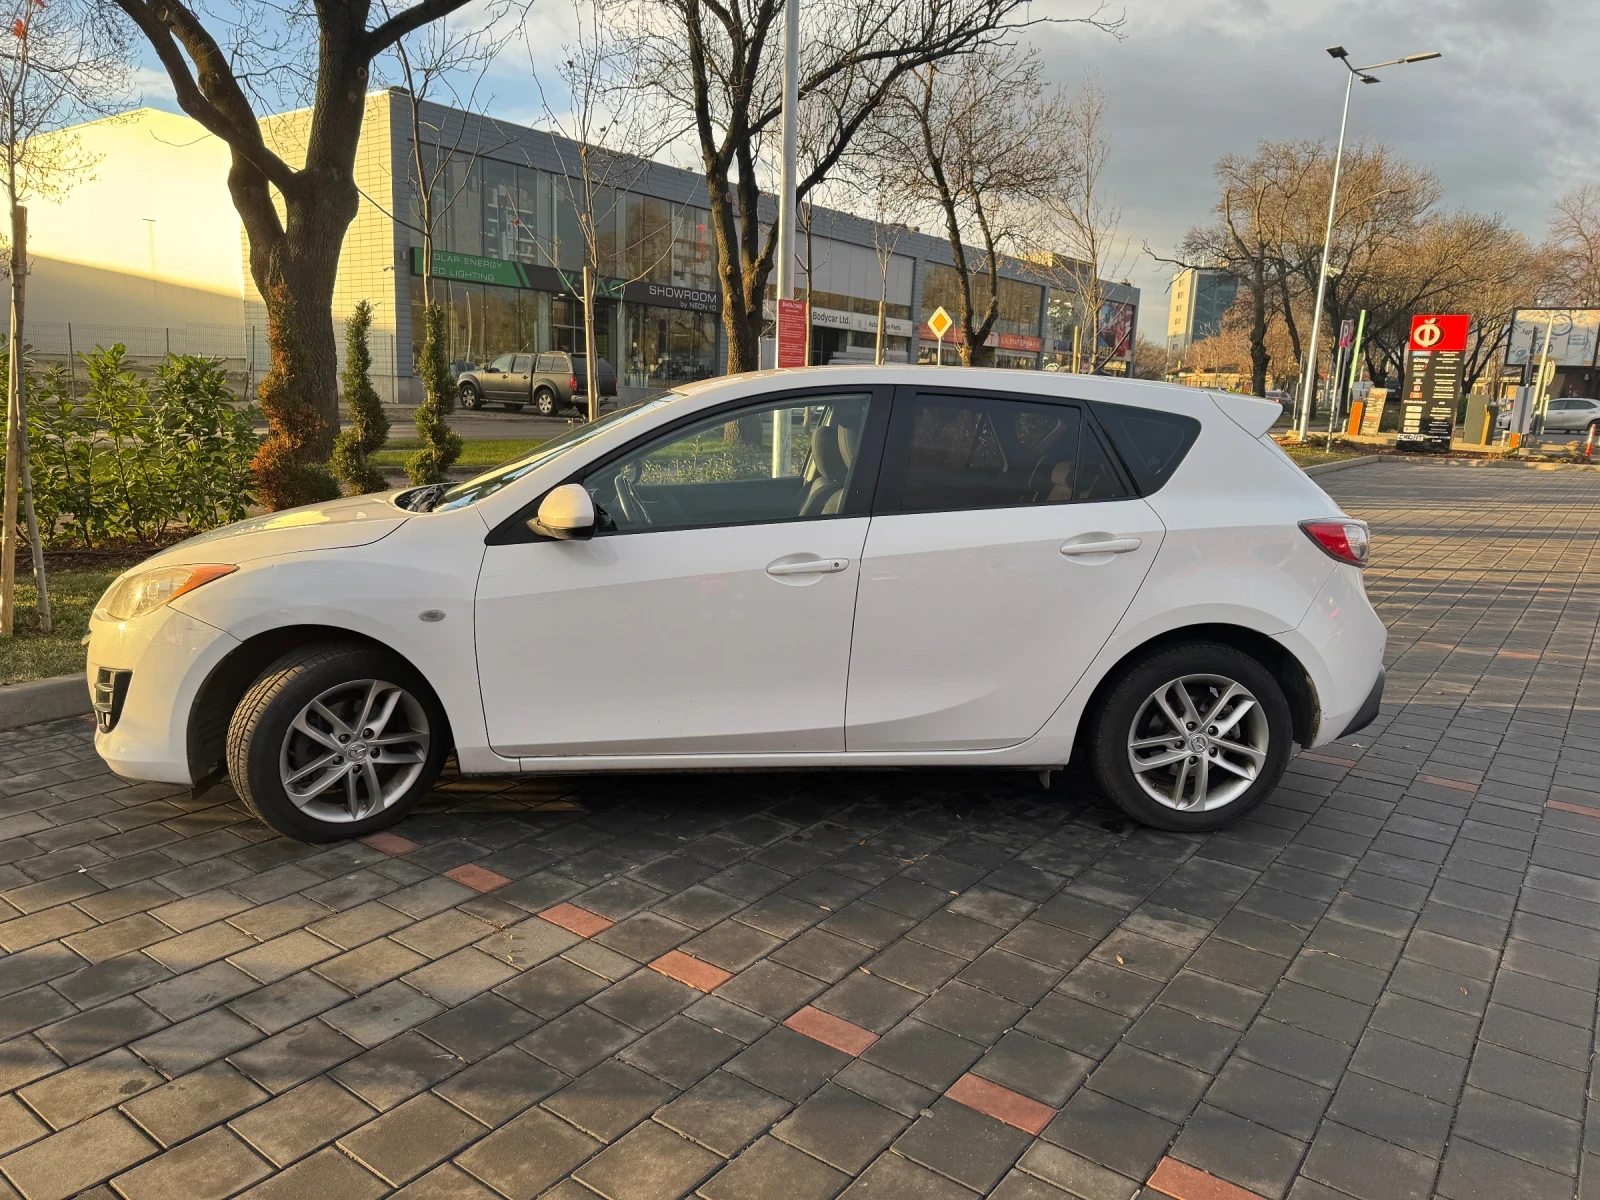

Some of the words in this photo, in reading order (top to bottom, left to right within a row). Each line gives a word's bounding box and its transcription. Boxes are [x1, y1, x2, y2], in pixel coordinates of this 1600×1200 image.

[433, 253, 460, 263] OLAR
[464, 257, 503, 269] ENERGY
[432, 266, 446, 275] ED
[449, 269, 495, 282] LIGHTING
[556, 271, 626, 299] V-AC
[649, 285, 717, 304] SHOWROOM
[680, 301, 688, 309] by
[689, 302, 708, 310] NEON
[812, 311, 839, 323] Bodycar
[839, 314, 851, 325] Ltd.
